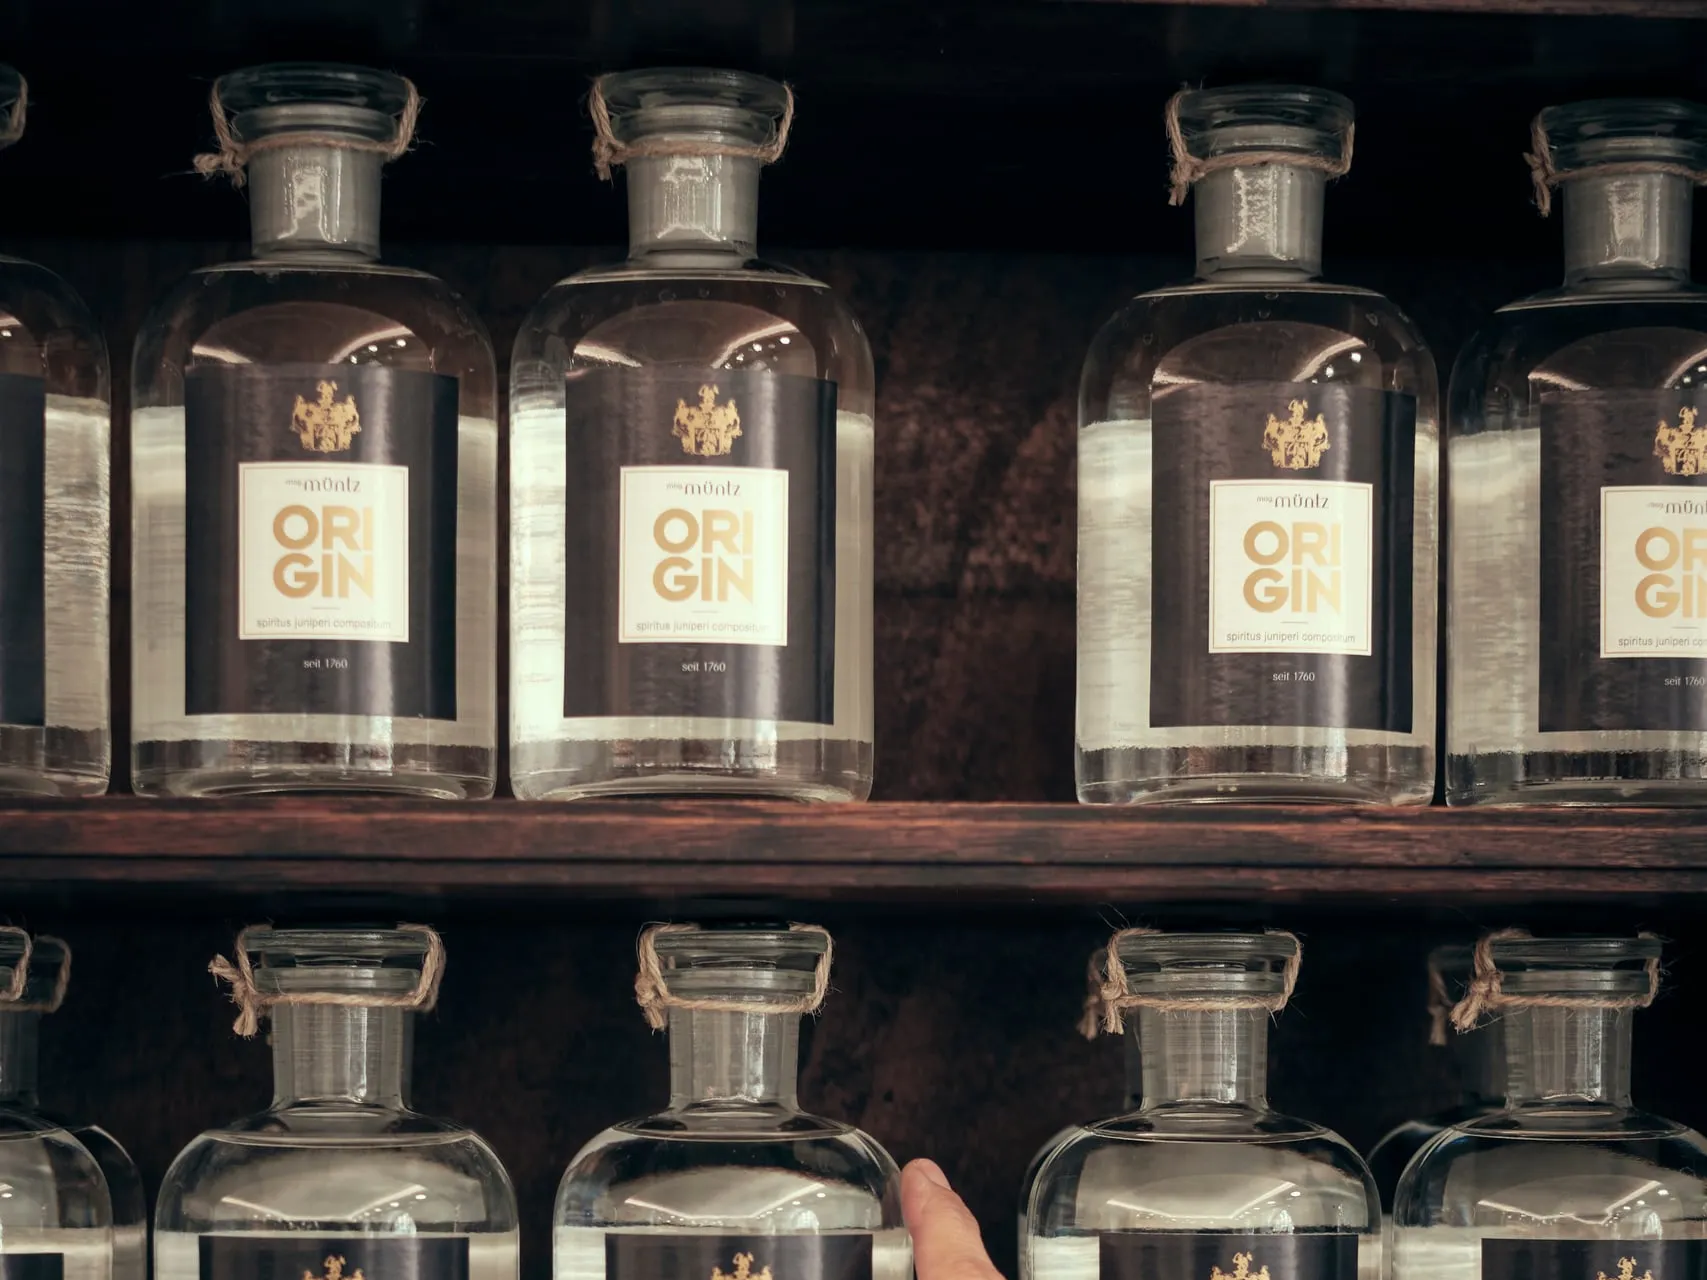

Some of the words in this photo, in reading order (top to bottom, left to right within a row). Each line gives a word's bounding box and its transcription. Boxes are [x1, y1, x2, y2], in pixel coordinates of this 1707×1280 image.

[1274, 493, 1329, 509] müntz
[273, 504, 373, 551] ORI
[653, 508, 754, 554] ORI
[1243, 521, 1342, 566] ORI
[273, 552, 374, 599] GIN
[653, 556, 754, 604] GIN
[1243, 567, 1342, 615] GIN
[1635, 573, 1707, 618] GI
[256, 618, 291, 629] spiritus
[294, 618, 331, 630] juniperi
[636, 621, 670, 632] spiritus
[673, 621, 709, 633] juniperi
[1226, 632, 1261, 643] spiritus
[1263, 631, 1299, 643] juniperi
[1301, 632, 1356, 643] compositum
[1618, 637, 1653, 647] spiritus
[1655, 636, 1690, 648] juniperi
[303, 658, 320, 669] seit
[325, 658, 348, 669] 1760
[682, 662, 699, 673] seit
[704, 662, 726, 673] 1760
[1273, 671, 1290, 682] seit
[1294, 672, 1315, 682] 1760
[1664, 676, 1681, 686] seit
[1685, 676, 1705, 686] 1760
